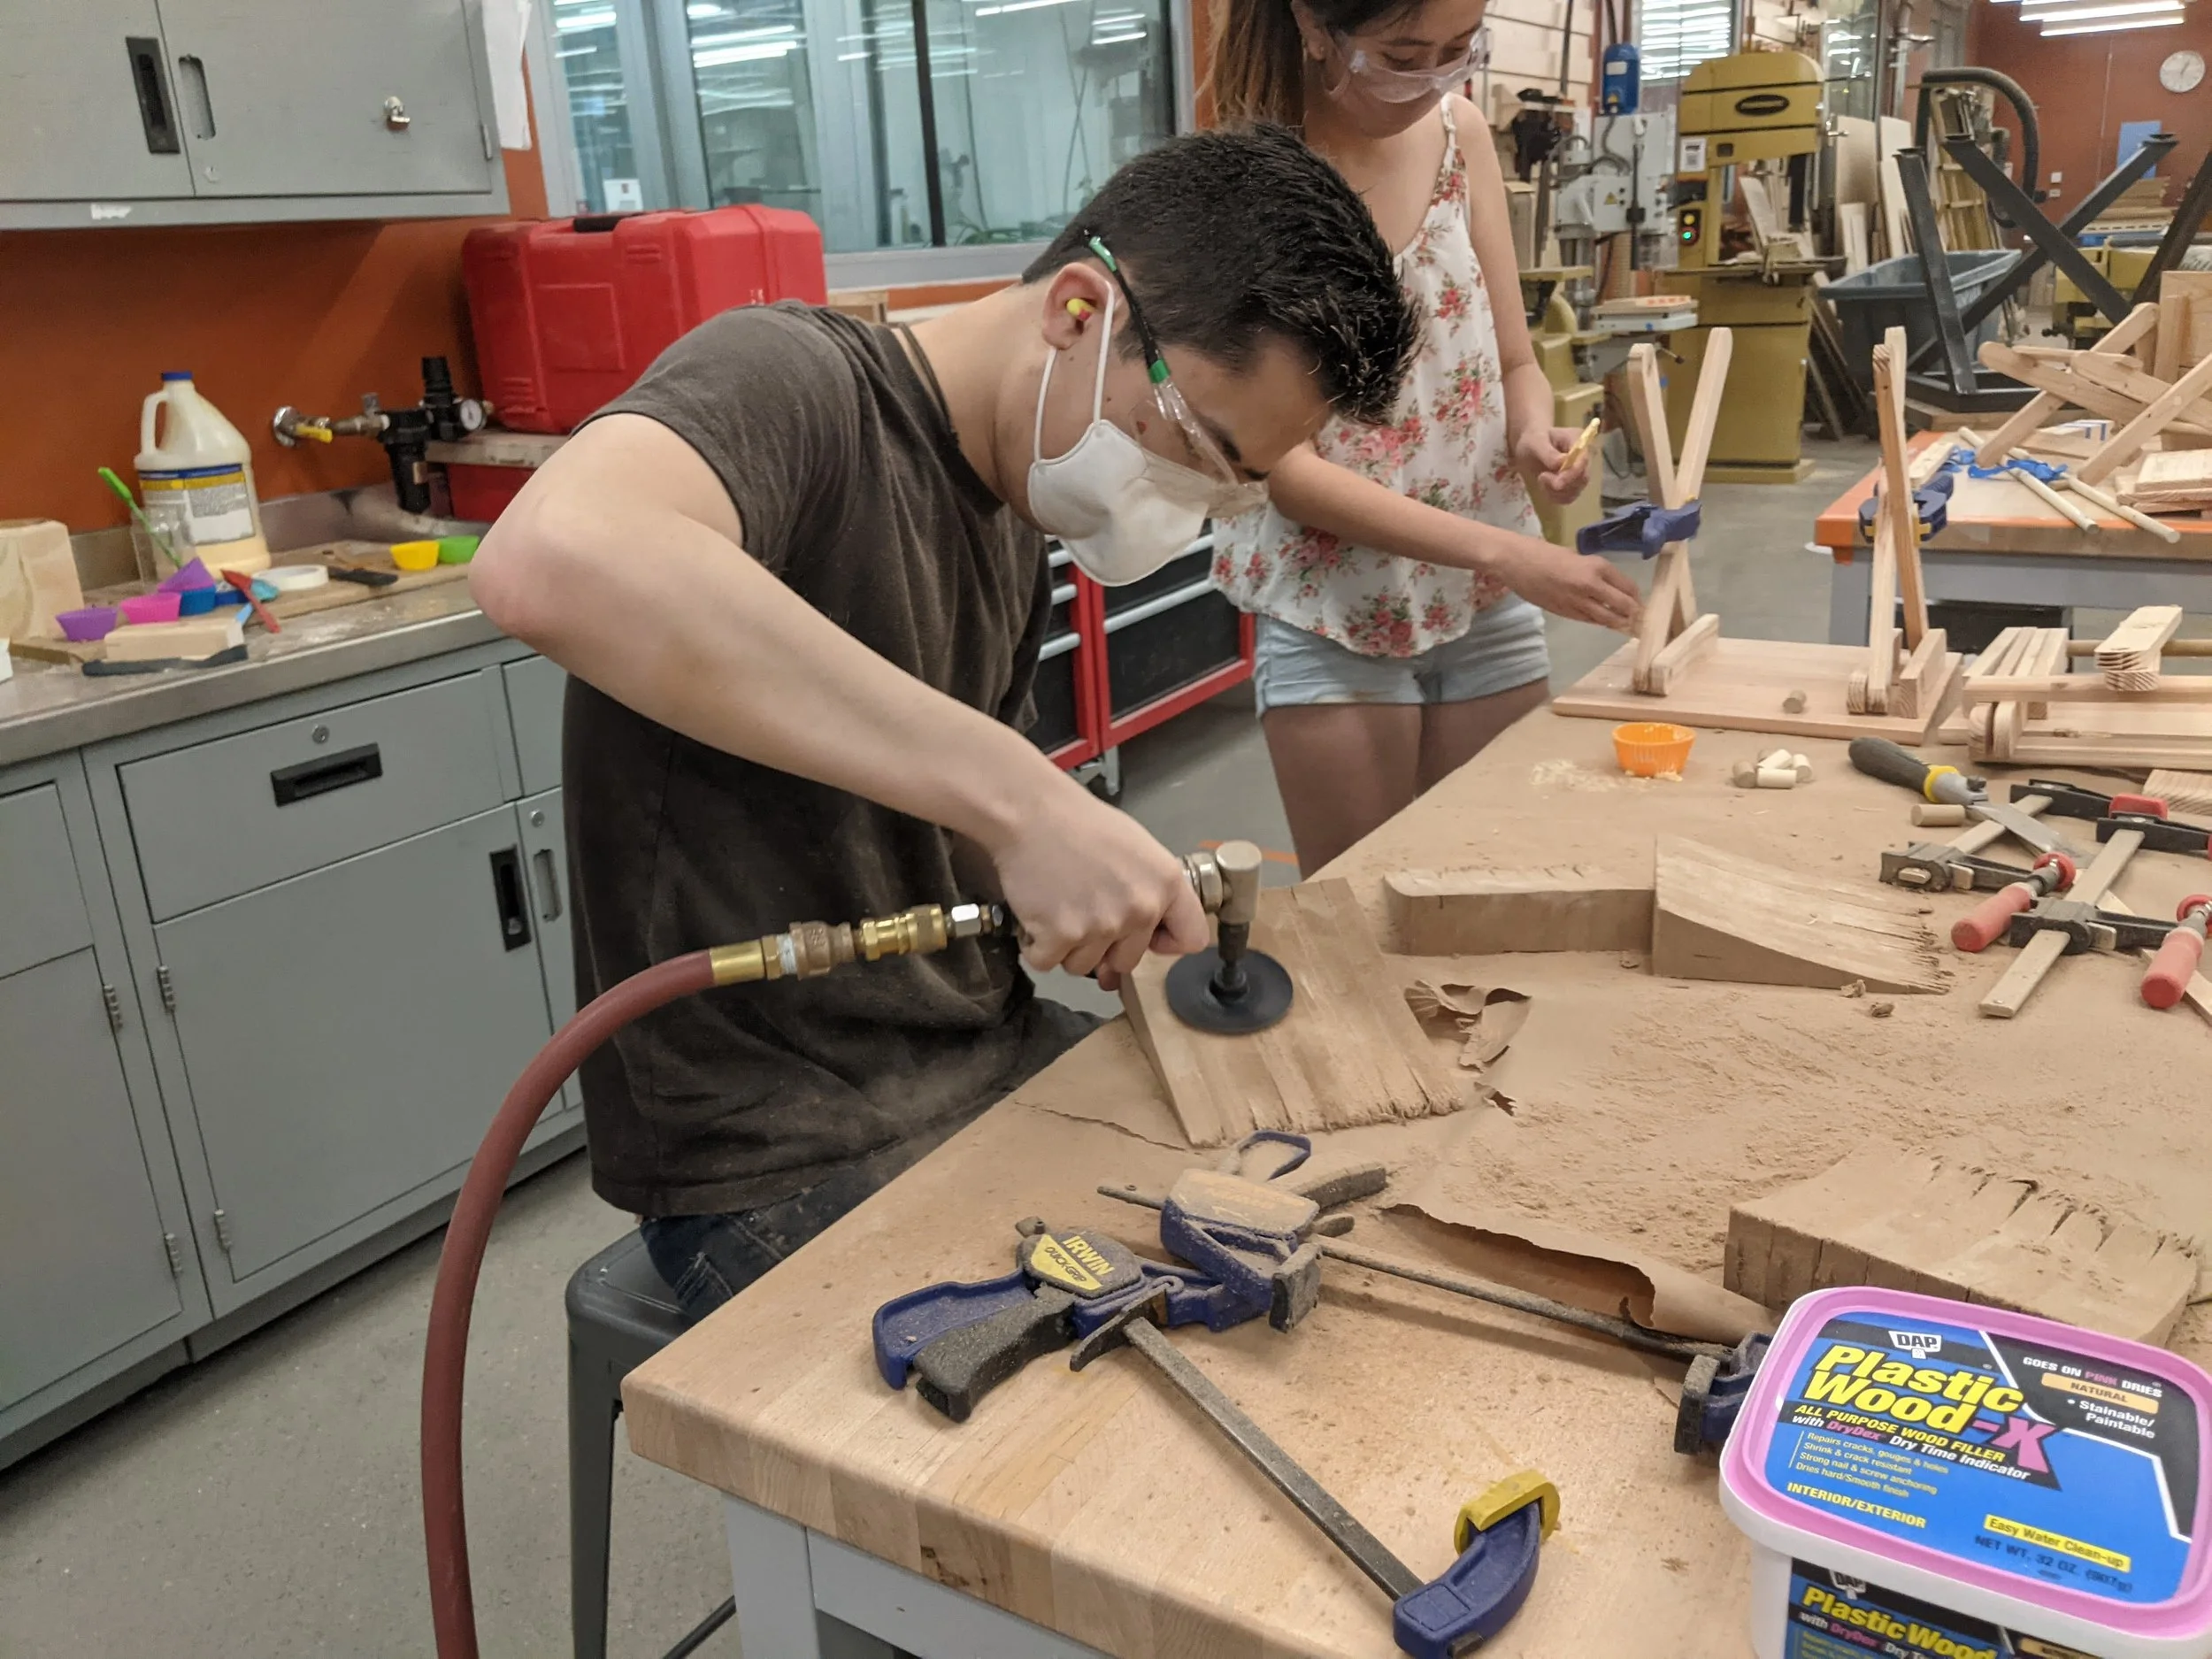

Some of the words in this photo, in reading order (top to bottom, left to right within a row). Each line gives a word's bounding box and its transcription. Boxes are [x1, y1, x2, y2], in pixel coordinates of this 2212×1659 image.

[1062, 1235, 1115, 1276] IRWIN
[1896, 1333, 1938, 1348] DAP
[1816, 1345, 2024, 1412] Plastic
[2023, 1356, 2058, 1371] GOES
[2062, 1366, 2081, 1377] ON
[2085, 1371, 2118, 1386] PINK
[2122, 1380, 2162, 1398] DRIES
[2070, 1382, 2128, 1403] NATURAL
[2079, 1400, 2155, 1427] Stainable/
[2085, 1412, 2155, 1439] Paintable
[1792, 1415, 1824, 1428] with
[1826, 1421, 1881, 1441] DryDex
[1889, 1435, 1917, 1452] Dry
[1921, 1443, 1958, 1461] Time
[1959, 1453, 2032, 1480] Indicator
[1794, 1404, 1824, 1417] ALL
[1826, 1410, 1899, 1434] PURPOSE
[1901, 1427, 1949, 1447] WOOD
[1951, 1440, 2006, 1463] FILLER
[1807, 1432, 1841, 1446] Repairs
[1878, 1449, 1911, 1463] gouges
[1914, 1458, 1921, 1467] &
[1800, 1452, 1830, 1466] Strong
[1832, 1459, 1848, 1470] nail
[1860, 1469, 1889, 1480] screw
[1890, 1475, 1938, 1495] anchoring
[1804, 1442, 1832, 1455] Shrink
[1844, 1451, 1869, 1463] crack
[1871, 1458, 1912, 1475] resistant
[1796, 1462, 1819, 1474] Dries
[1883, 1484, 1909, 1497] finish
[1786, 1482, 1927, 1529] INTERIOR/EXTERIOR
[1975, 1534, 2001, 1550] NET
[2035, 1554, 2054, 1566] 32
[1989, 1517, 2019, 1536] Easy
[2023, 1528, 2061, 1547] Water
[2063, 1540, 2124, 1568] Clean-up
[1800, 1612, 1828, 1630] with
[1802, 1586, 1906, 1640] Plastic
